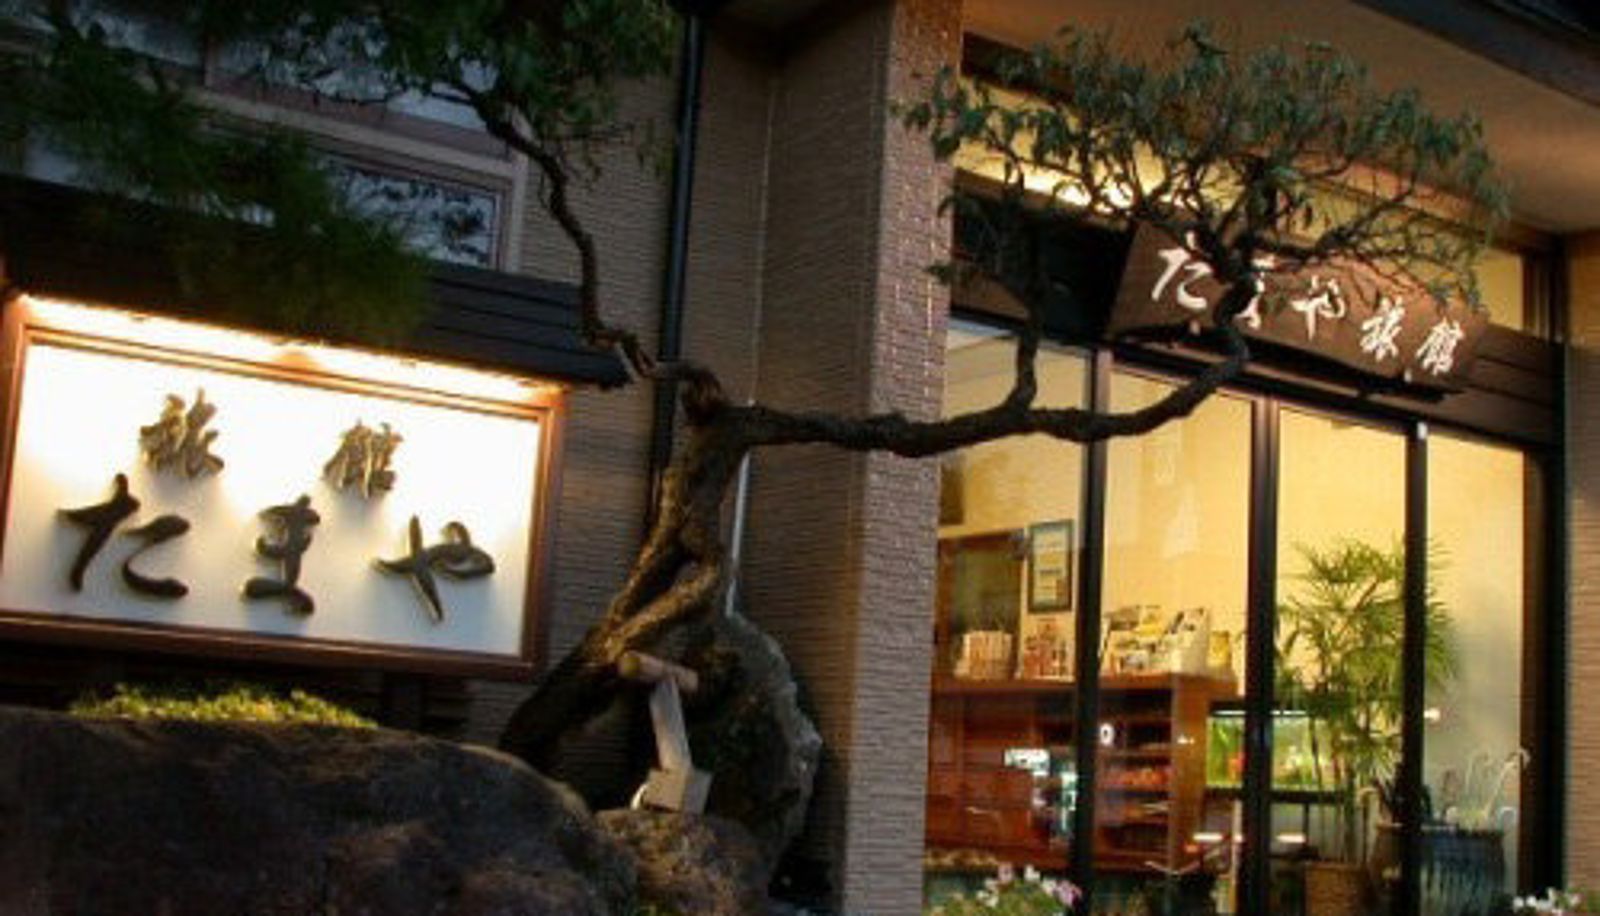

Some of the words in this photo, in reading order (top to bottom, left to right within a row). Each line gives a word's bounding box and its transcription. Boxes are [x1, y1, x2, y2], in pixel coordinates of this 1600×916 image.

[138, 387, 402, 499] 旅館
[56, 473, 496, 622] たまや
